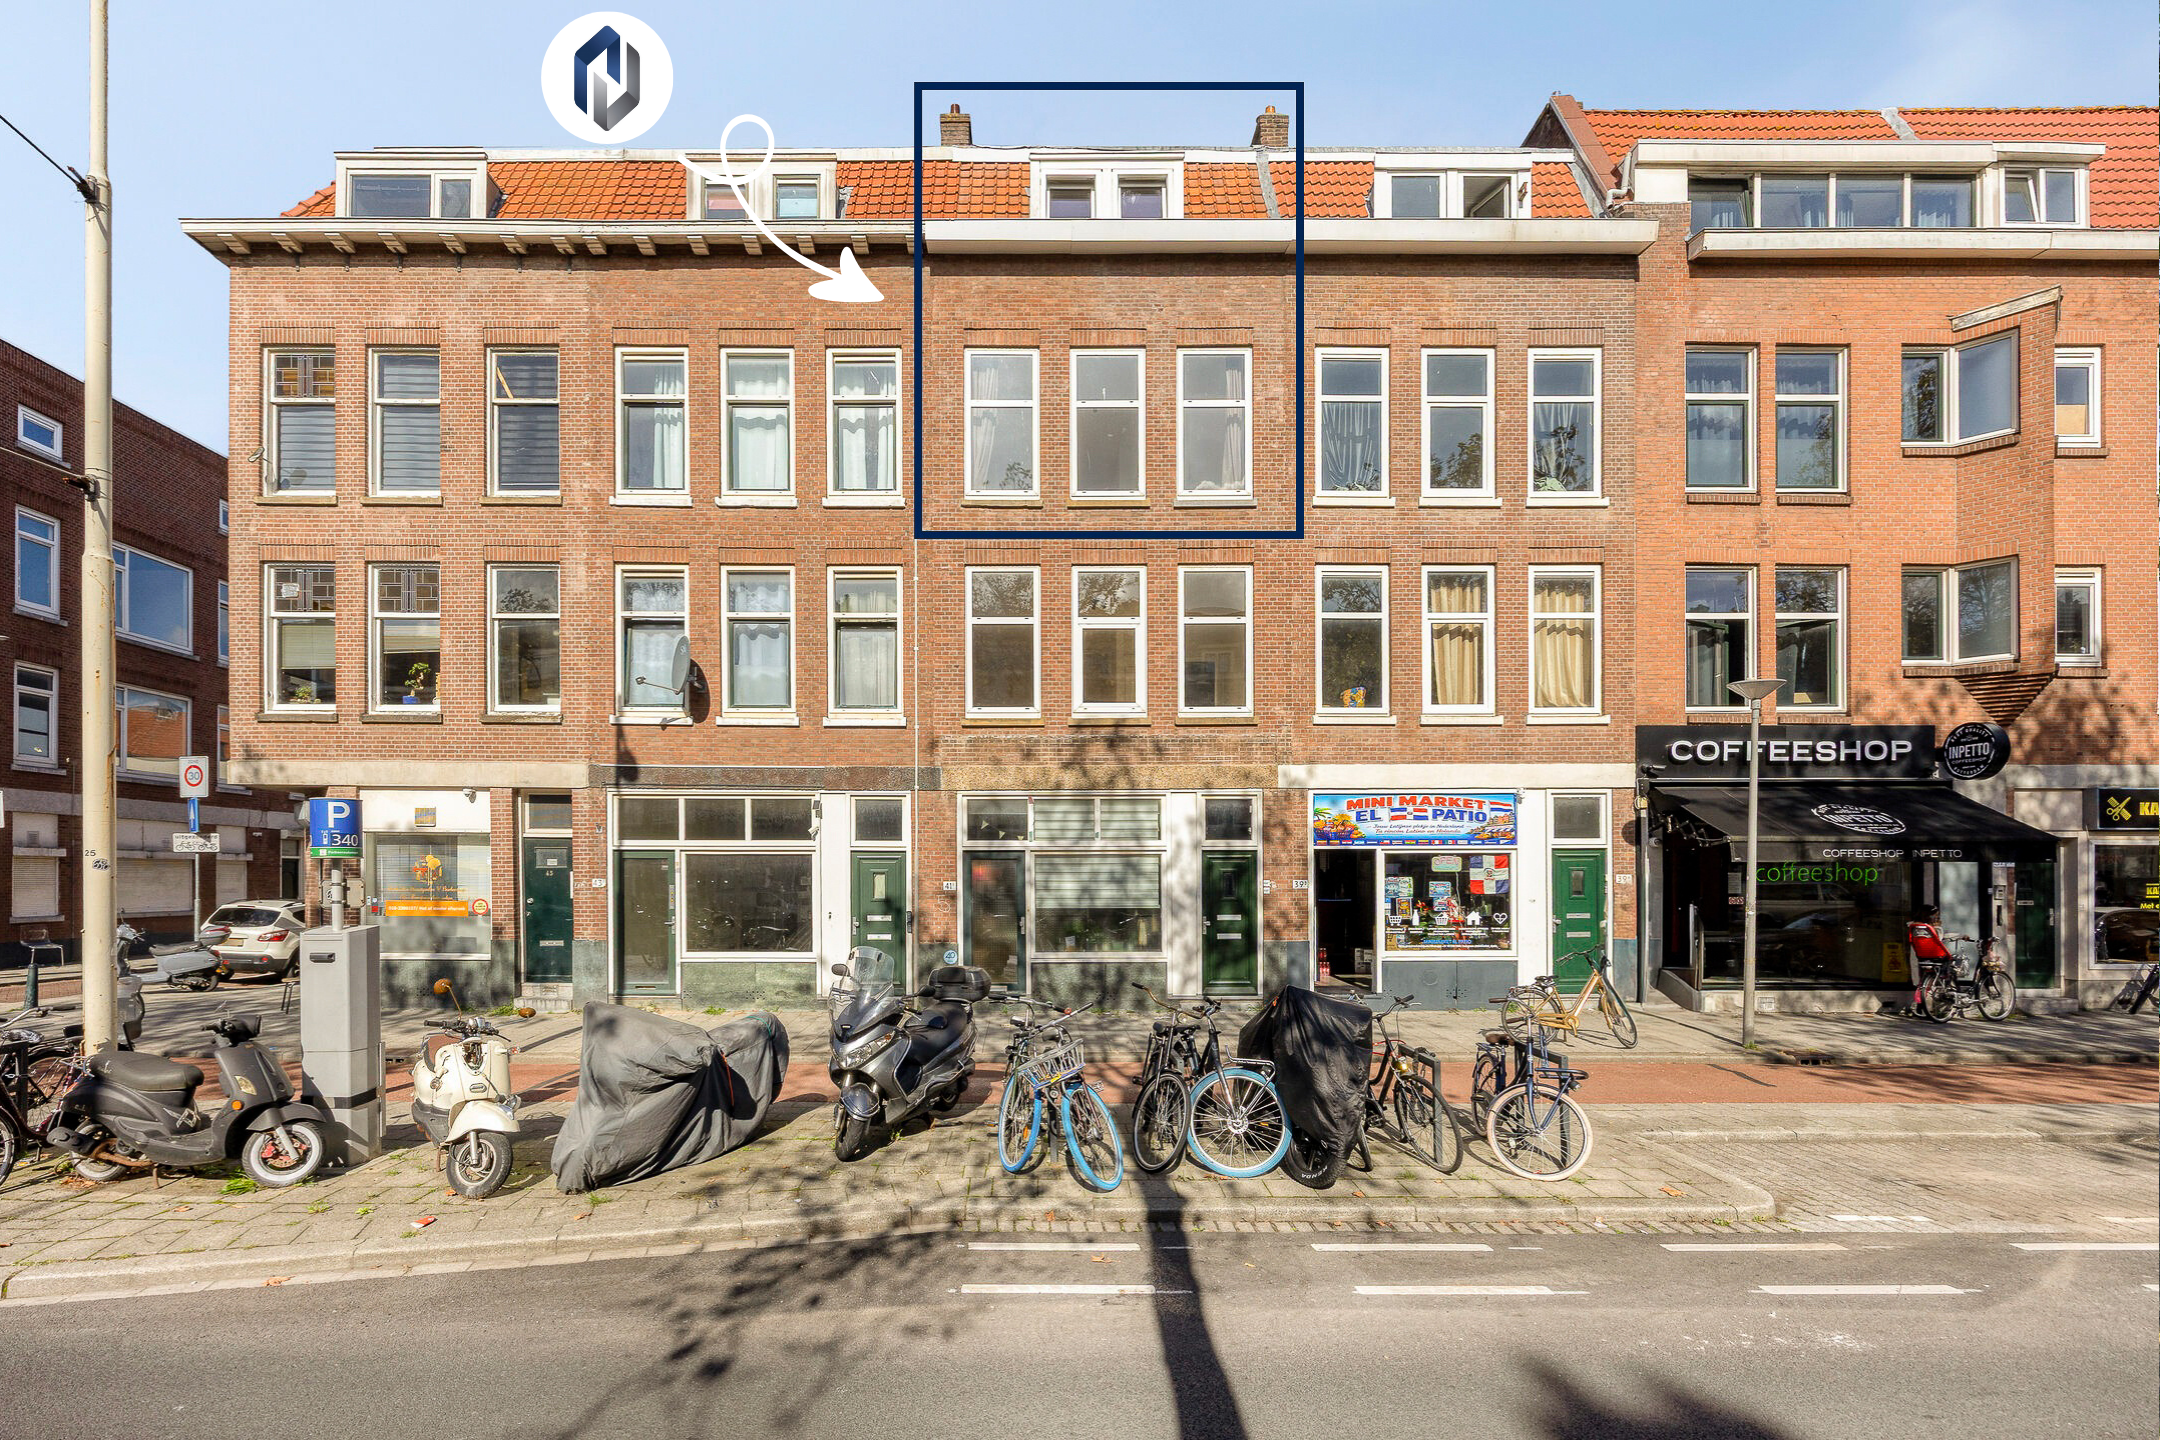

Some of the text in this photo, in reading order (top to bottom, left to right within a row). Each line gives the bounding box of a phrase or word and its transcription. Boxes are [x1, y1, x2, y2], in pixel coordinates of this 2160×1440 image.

[1671, 740, 1912, 761] COFFEESHOP
[1948, 742, 1990, 759] INPETTO
[188, 771, 200, 781] 30
[1346, 795, 1487, 810] MINI MARKET
[327, 801, 351, 829] P
[1355, 809, 1488, 823] EL PATIO
[331, 833, 359, 847] 340
[84, 849, 97, 857] 25
[1822, 849, 1963, 858] COFFEESHOP INPETTO
[1756, 861, 1878, 886] coffeeshop
